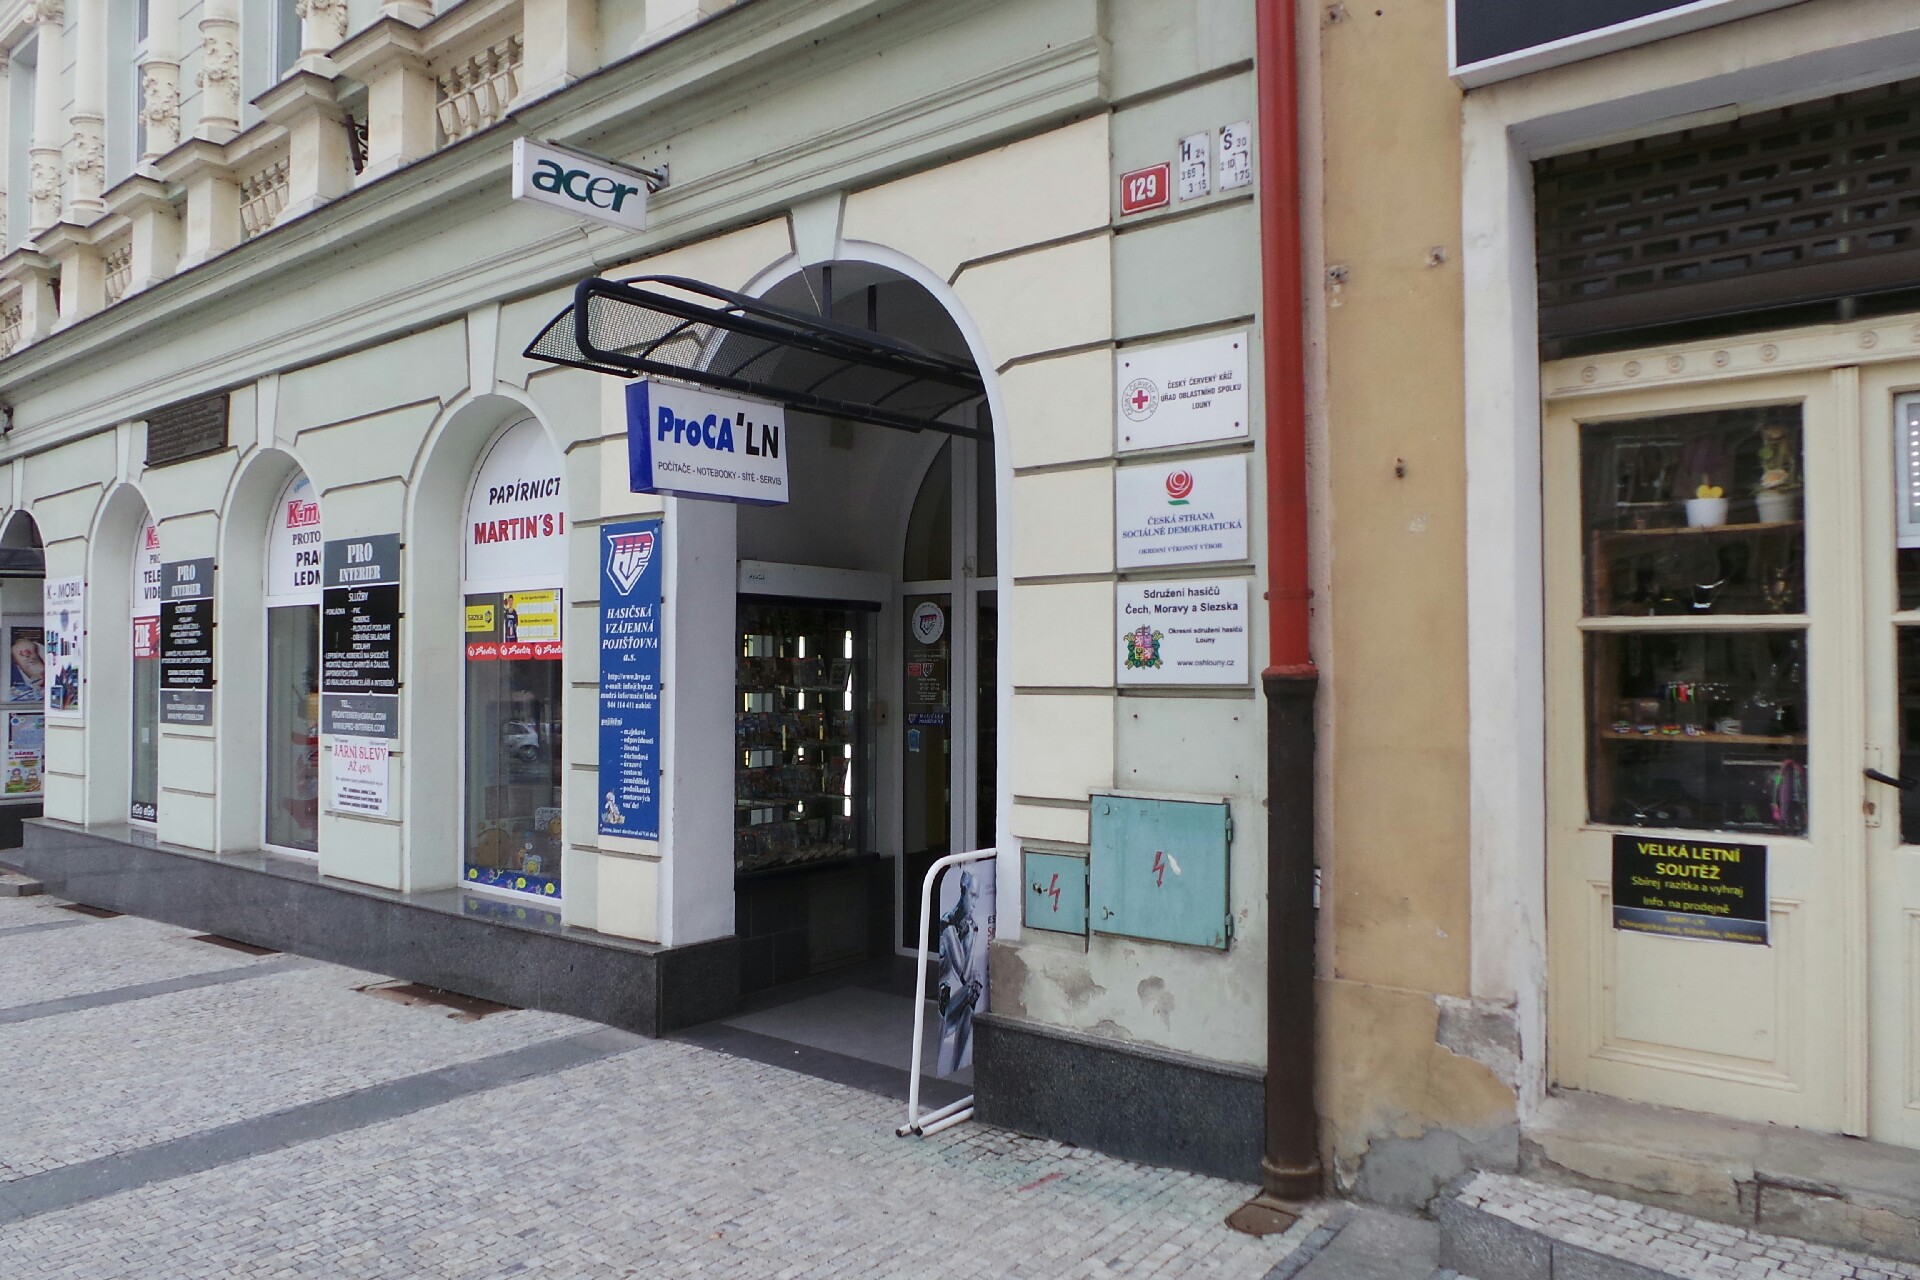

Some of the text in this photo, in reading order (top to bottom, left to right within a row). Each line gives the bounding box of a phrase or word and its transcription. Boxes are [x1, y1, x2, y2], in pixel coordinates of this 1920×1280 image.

[1223, 128, 1233, 150] Š
[1236, 137, 1247, 147] 30
[1181, 143, 1191, 162] H
[1195, 148, 1205, 158] 24
[532, 159, 638, 213] acer
[1129, 174, 1156, 203] 129
[1217, 383, 1242, 393] SPOLKU
[1192, 400, 1212, 410] LOUNY
[697, 467, 737, 480] NOTEBOOKY
[760, 475, 782, 486] SERVIS
[1147, 511, 1215, 526] ČESKÁ STRANA
[1167, 519, 1242, 535] DEMOKRATICKÁ
[348, 543, 374, 564] PRO
[177, 564, 196, 582] PRO
[340, 565, 382, 582] INTERIER
[47, 584, 52, 599] K
[58, 582, 81, 598] MOBIL
[1143, 586, 1220, 599] Sdružení hasičů
[607, 604, 653, 618] HASIČSKÁ
[1125, 604, 1152, 615] Čech,
[1154, 604, 1189, 615] Moravy
[1200, 602, 1239, 613] Slezska
[605, 619, 654, 634] VZÁJEMNÁ
[1168, 626, 1192, 634] Okresní
[602, 636, 658, 650] POJIŠŤOVNA
[623, 653, 636, 661] a.s.
[359, 746, 387, 760] SLEVY
[1637, 842, 1741, 862] VELKÁ LETNÍ
[1656, 862, 1721, 880] SOUTĚŽ
[1631, 875, 1661, 890] Sbírej
[1665, 880, 1699, 891] razítka
[1710, 884, 1744, 898] vyhraj
[1668, 901, 1681, 909] na
[1683, 901, 1731, 915] prodejně
